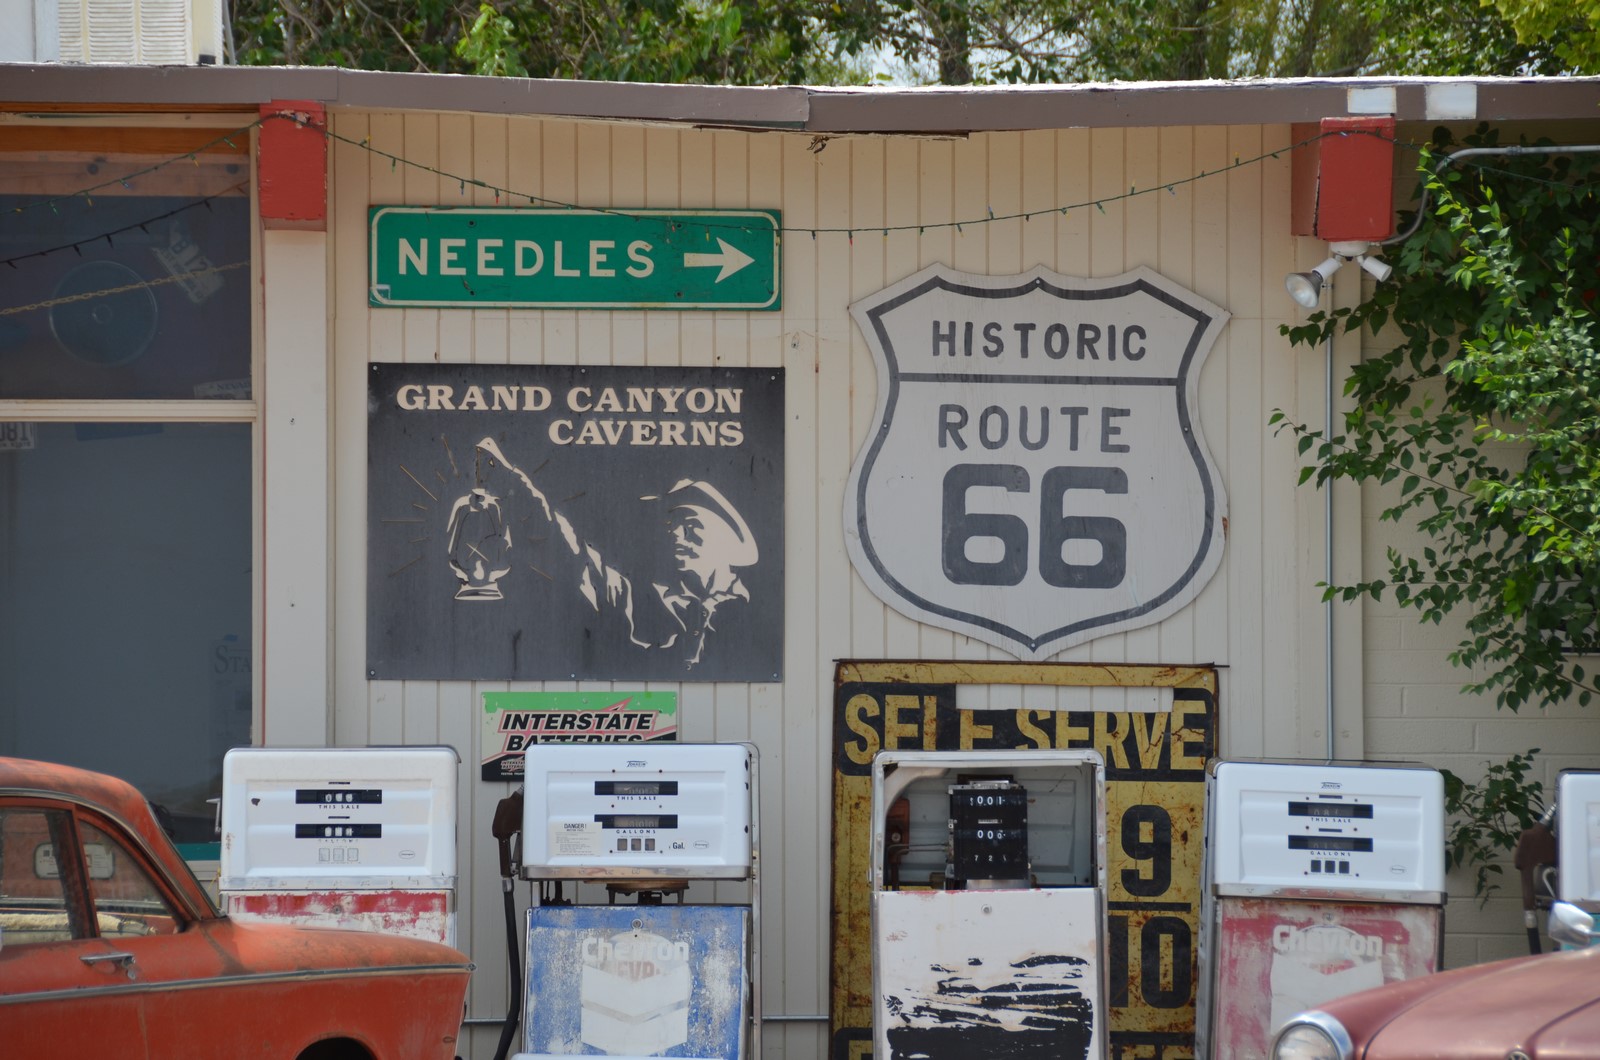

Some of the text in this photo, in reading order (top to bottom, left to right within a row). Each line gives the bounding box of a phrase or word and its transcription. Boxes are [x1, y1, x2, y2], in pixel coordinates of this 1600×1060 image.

[398, 238, 655, 278] NEEDLES
[932, 320, 1147, 361] HISTORIC
[396, 385, 743, 414] GRAND CANYON
[548, 420, 744, 447] CAVERNS
[937, 404, 1131, 453] ROUTE
[941, 463, 1129, 590] 66
[501, 713, 653, 730] INTERSTATE
[672, 841, 686, 850] Gal.
[1120, 804, 1172, 897] 9
[582, 936, 690, 962] Chevron
[1108, 915, 1192, 1009] 10
